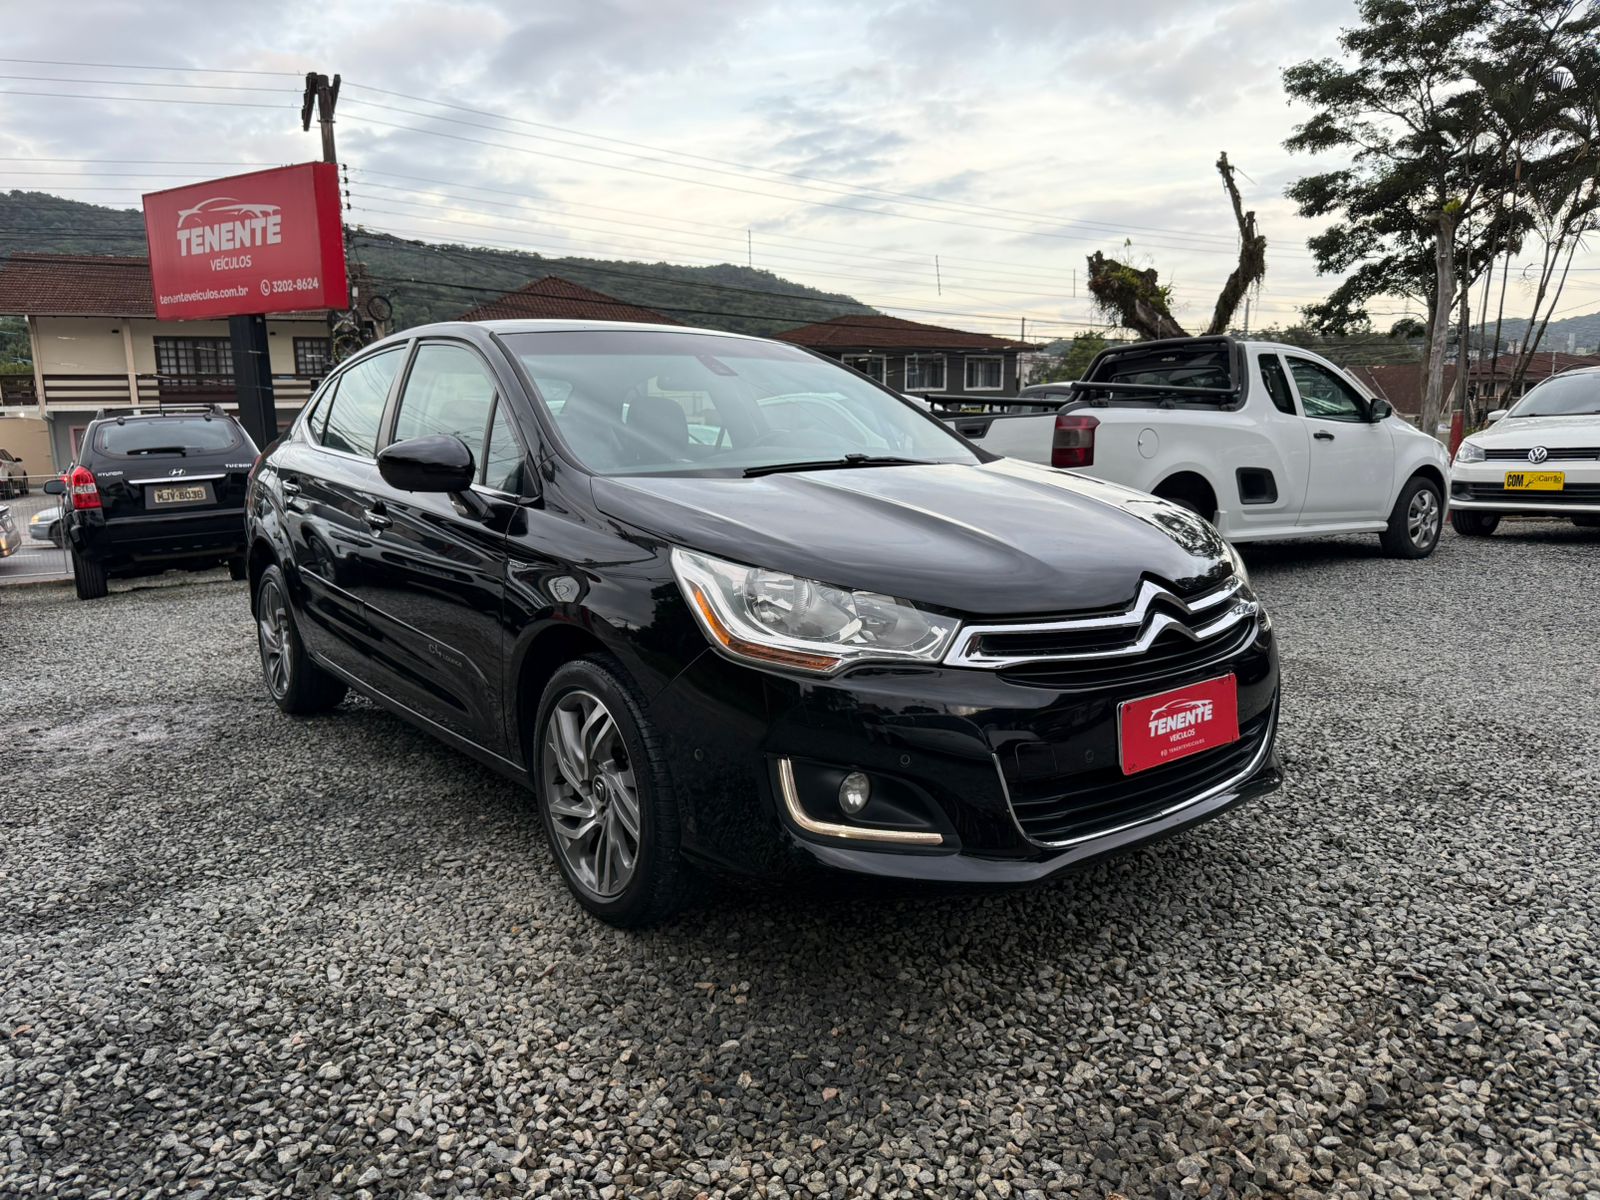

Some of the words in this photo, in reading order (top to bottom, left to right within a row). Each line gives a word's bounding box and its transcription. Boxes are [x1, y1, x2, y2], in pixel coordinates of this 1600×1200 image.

[177, 215, 281, 256] TENENTE
[210, 255, 252, 271] VEÍCULOS
[272, 277, 319, 293] 3202-8624
[1507, 474, 1524, 487] COM
[1149, 704, 1213, 737] TENENTE
